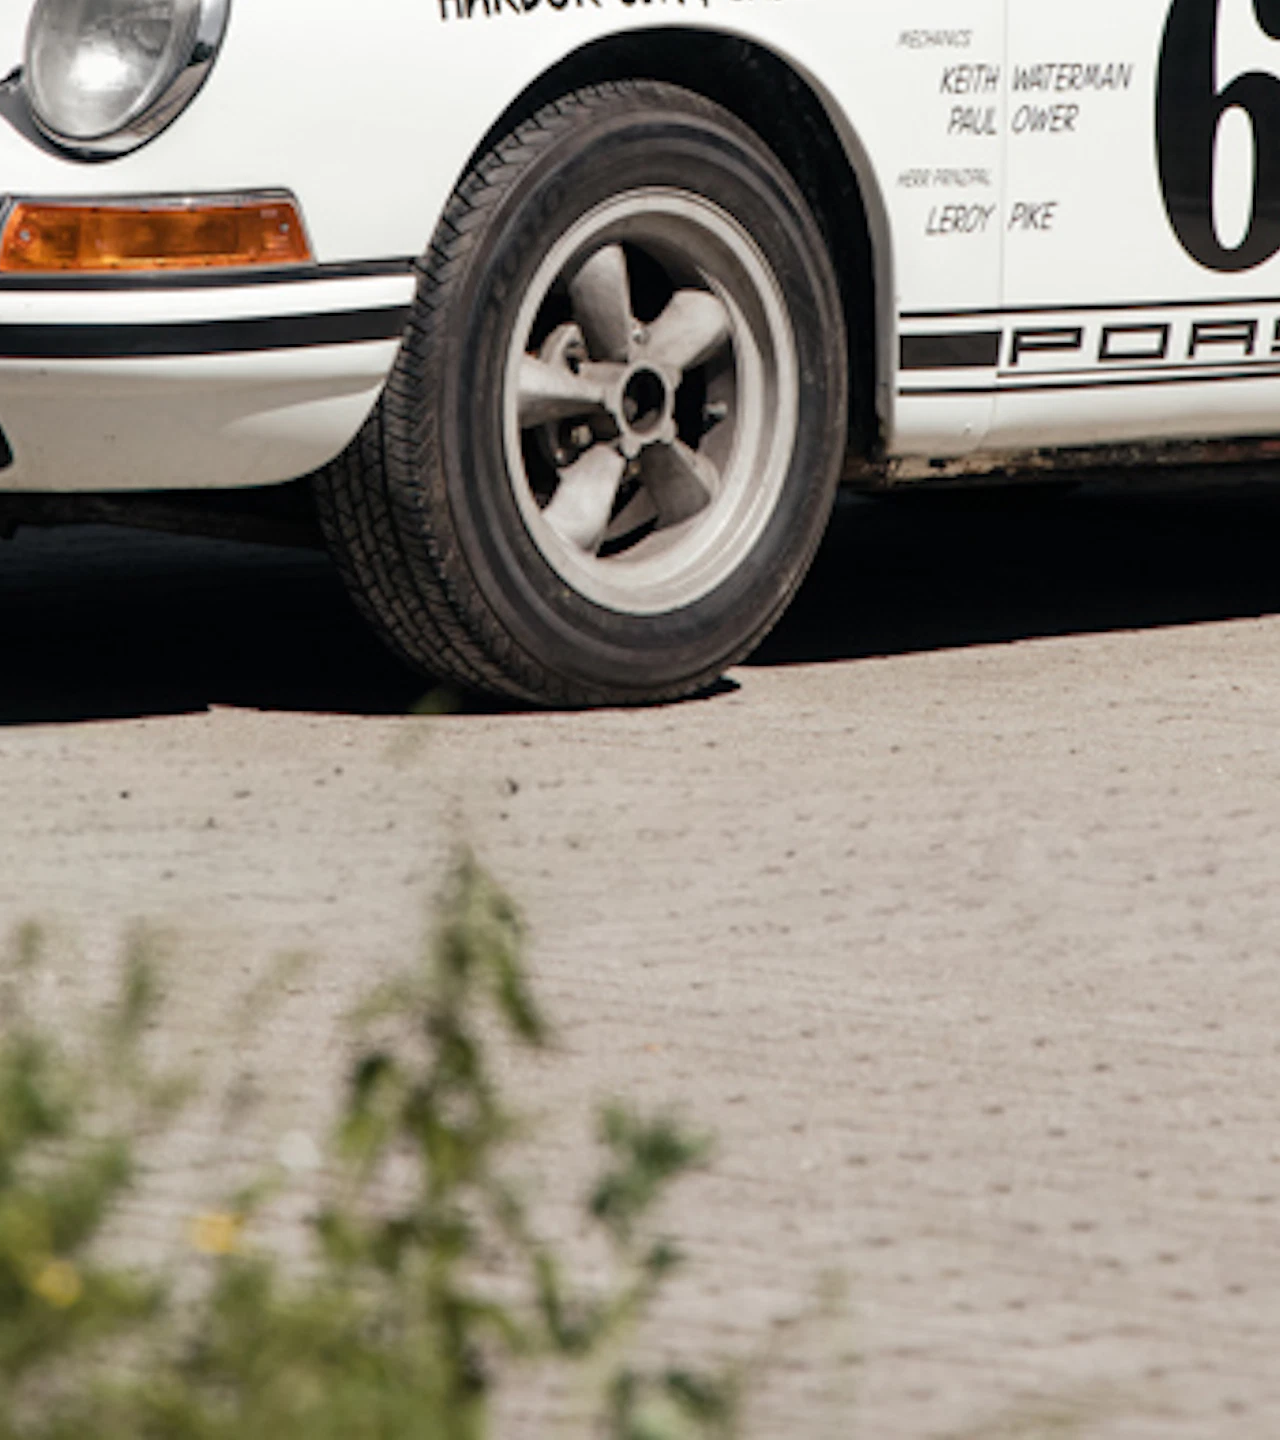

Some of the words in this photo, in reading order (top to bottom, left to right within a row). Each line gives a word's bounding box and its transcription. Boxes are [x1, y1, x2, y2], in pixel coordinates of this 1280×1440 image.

[939, 63, 1000, 95] KEITH
[1011, 62, 1134, 93] WATERMAN
[947, 106, 998, 136] PAUL
[1011, 103, 1080, 135] OWER
[925, 203, 996, 237] LEROY
[1007, 200, 1059, 231] PIKE
